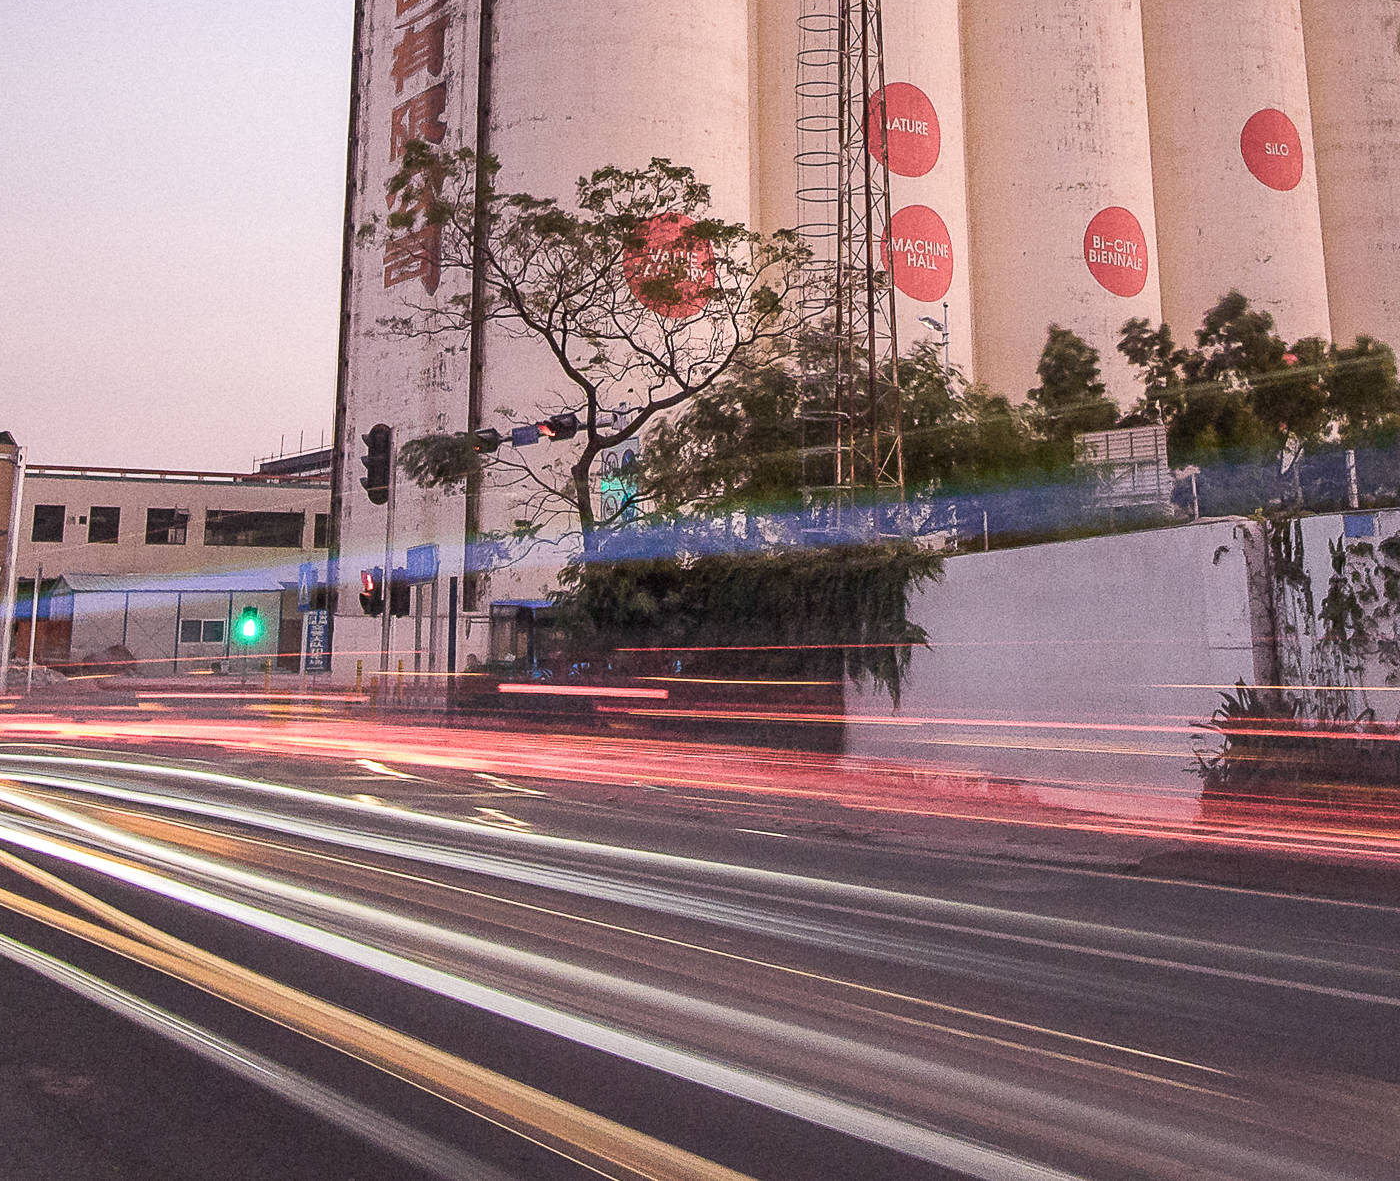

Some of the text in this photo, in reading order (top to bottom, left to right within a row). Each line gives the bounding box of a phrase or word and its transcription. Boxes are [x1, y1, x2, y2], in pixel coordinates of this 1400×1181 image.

[879, 116, 929, 136] NATURE
[1264, 141, 1289, 157] SILO
[890, 236, 950, 259] MACHINE
[1092, 234, 1138, 256] BI-CITY
[906, 252, 939, 271] HALL
[1087, 248, 1143, 271] BIENNALE
